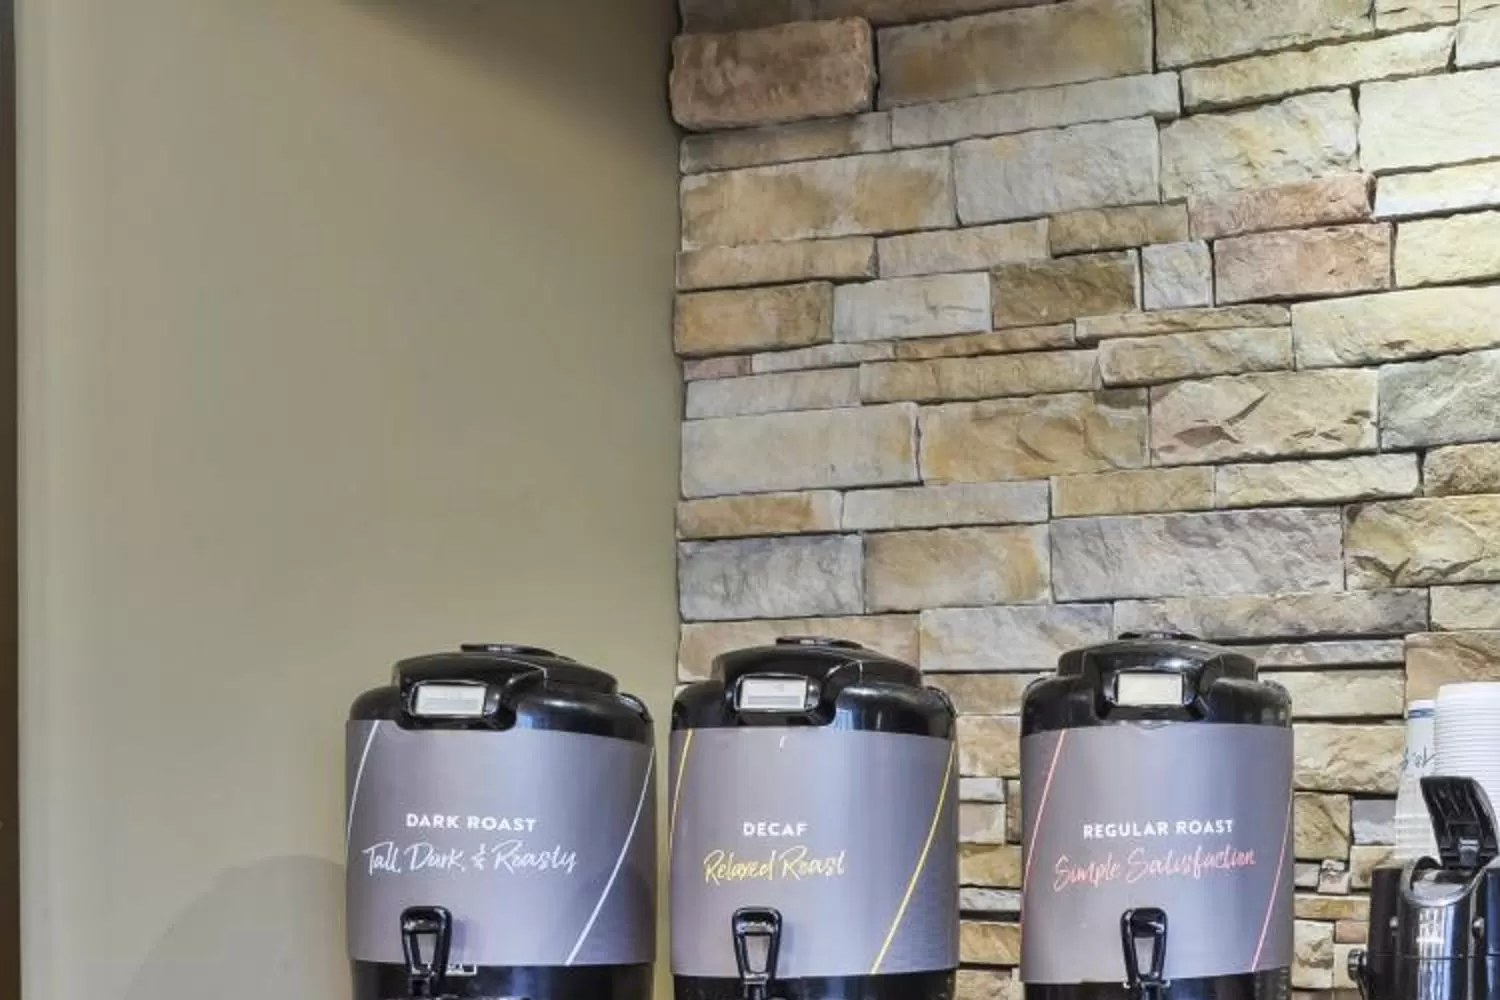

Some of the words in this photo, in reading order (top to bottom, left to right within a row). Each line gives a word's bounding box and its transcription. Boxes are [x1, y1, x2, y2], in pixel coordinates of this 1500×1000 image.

[405, 812, 461, 830] DARK
[466, 814, 537, 832] ROAST
[742, 820, 809, 837] DECAF
[1083, 820, 1169, 840] REGULAR
[1176, 818, 1234, 835] ROAST
[470, 842, 487, 871] &
[703, 848, 777, 887] Relaxed
[778, 844, 847, 881] Roast
[1053, 853, 1121, 893] Simple
[1125, 843, 1257, 884] Satisfaction
